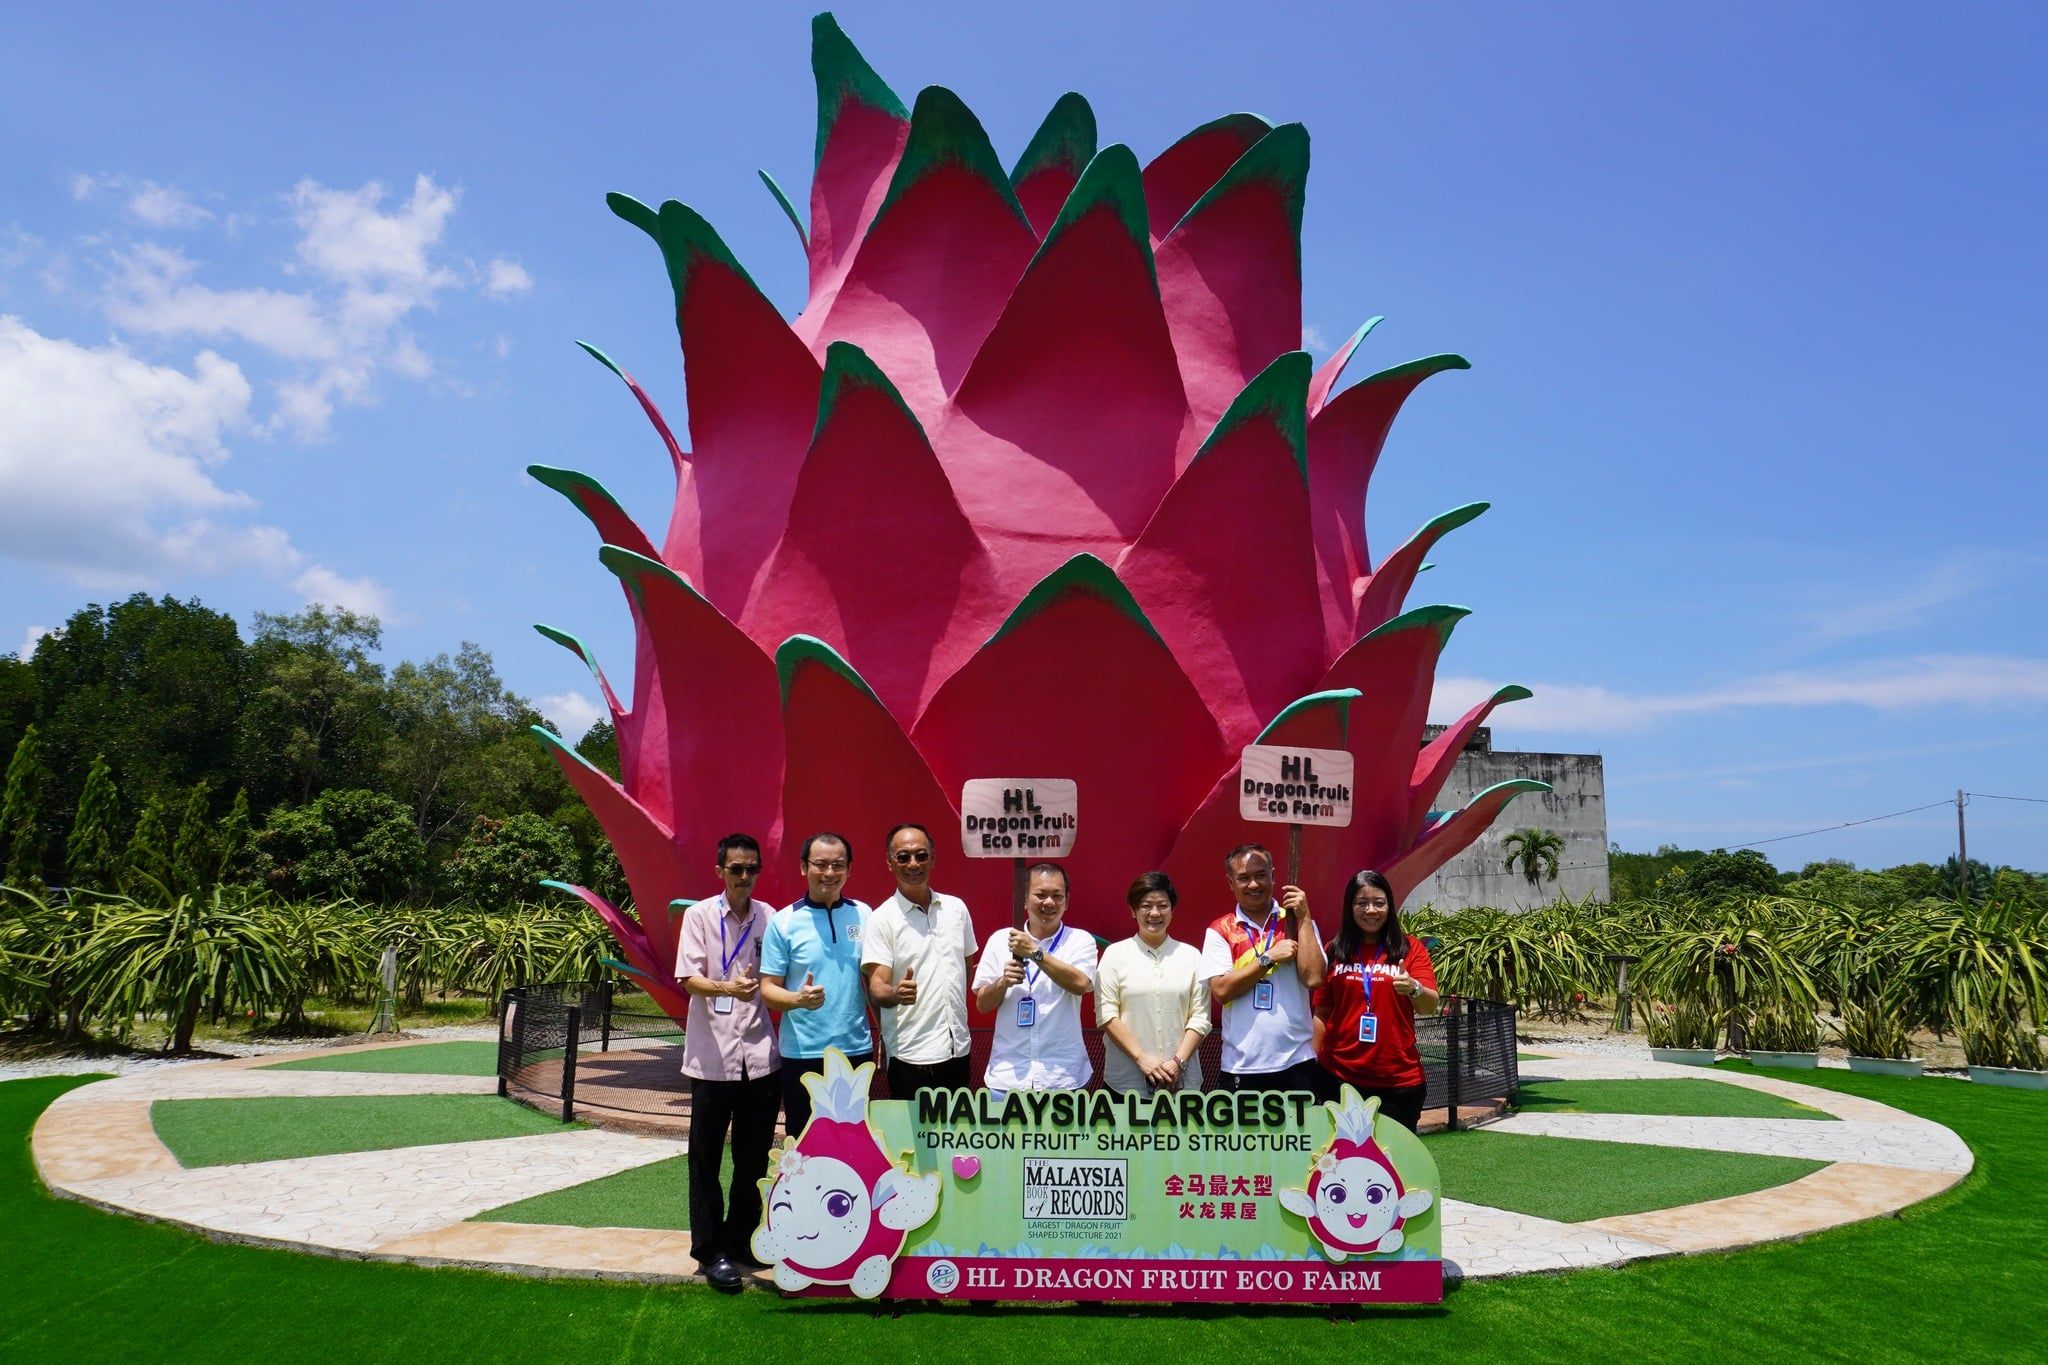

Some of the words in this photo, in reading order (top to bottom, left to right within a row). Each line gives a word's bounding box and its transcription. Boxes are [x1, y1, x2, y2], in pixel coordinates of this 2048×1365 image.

[1281, 756, 1318, 782] HL
[1003, 788, 1042, 813] HL
[1244, 779, 1306, 799] Dragon
[1309, 784, 1349, 801] Fruit
[1258, 798, 1288, 814] Eco
[1293, 800, 1334, 817] Farm
[966, 814, 1030, 834] Dragon
[1034, 812, 1075, 830] Fruit
[982, 833, 1012, 849] Eco
[1017, 833, 1060, 849] Farm
[919, 1091, 1116, 1126] MALAYSIA
[1128, 1094, 1312, 1127] LARGEST
[917, 1131, 1015, 1150] “DRAGON
[1021, 1132, 1090, 1151] FRUIT”
[1097, 1133, 1181, 1151] SHAPED
[1188, 1134, 1312, 1152] STRUCTURE
[1026, 1166, 1125, 1187] MALAYSIA
[1164, 1174, 1273, 1197] 全马最大型
[1026, 1187, 1048, 1199] BOOK
[1030, 1199, 1048, 1217] of
[1050, 1190, 1124, 1216] RECORDS
[1179, 1202, 1257, 1220] 火龙果屋
[1028, 1231, 1059, 1239] SHAPED
[1060, 1231, 1102, 1240] STRUCTURE
[1104, 1232, 1122, 1240] 2021
[966, 1268, 1005, 1288] HL
[1014, 1268, 1133, 1289] DRAGON
[1141, 1269, 1228, 1290] FRUIT
[1236, 1270, 1294, 1290] ECO
[1302, 1271, 1382, 1291] FARM
